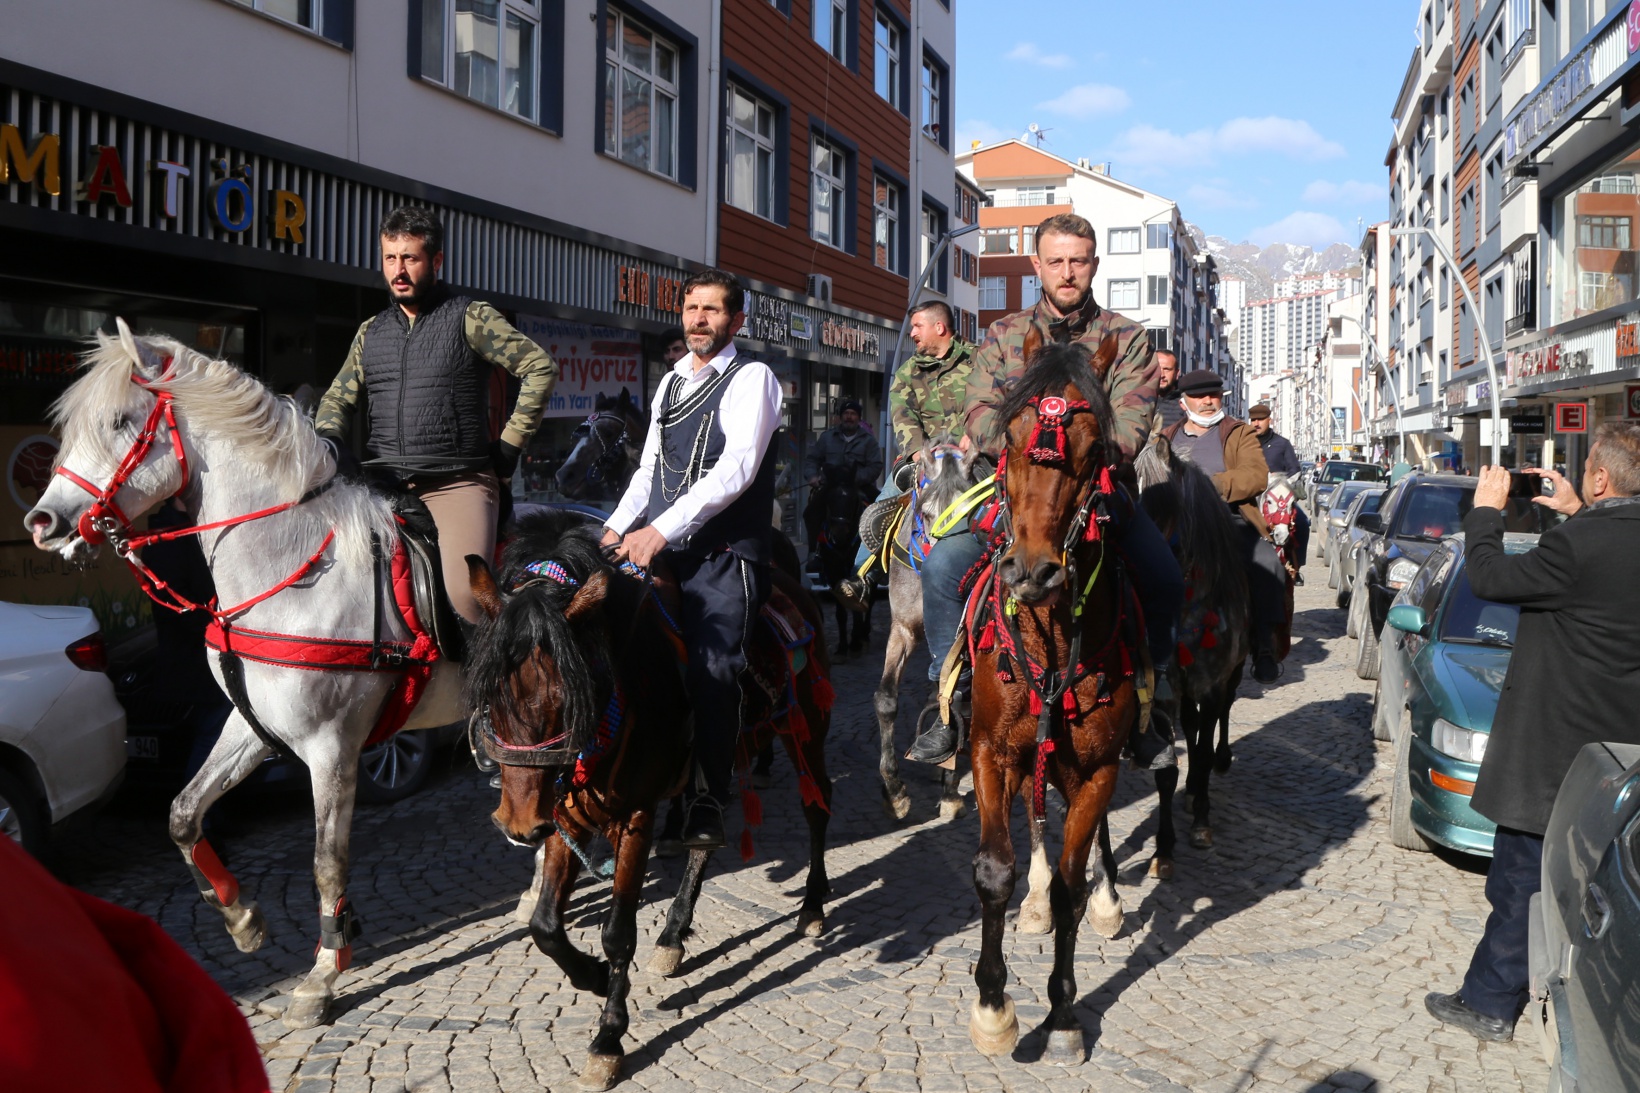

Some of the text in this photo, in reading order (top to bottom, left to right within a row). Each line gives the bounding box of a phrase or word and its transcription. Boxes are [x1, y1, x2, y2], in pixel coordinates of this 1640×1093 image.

[0, 122, 306, 244] MATÖR
[1517, 343, 1561, 378] ECZANE
[1563, 408, 1580, 427] E
[135, 737, 157, 756] 940
